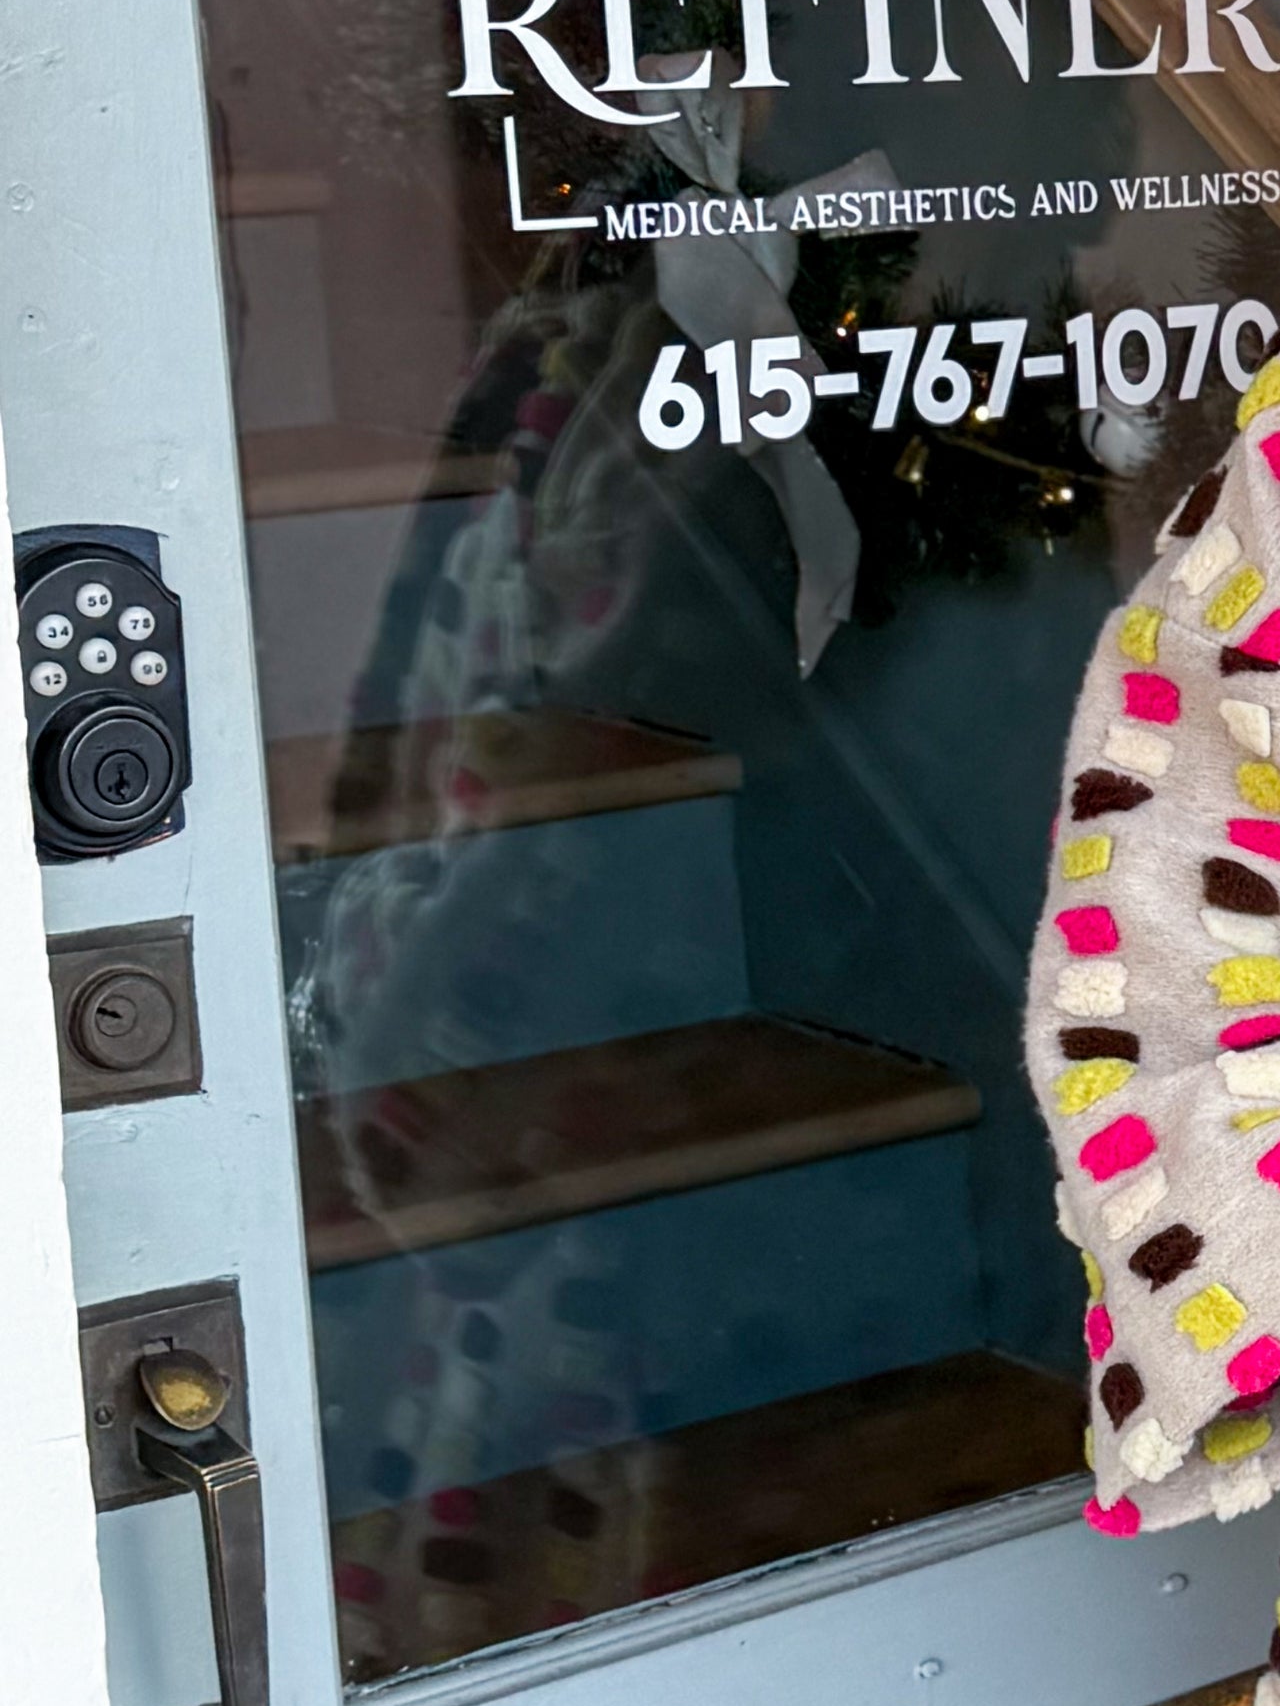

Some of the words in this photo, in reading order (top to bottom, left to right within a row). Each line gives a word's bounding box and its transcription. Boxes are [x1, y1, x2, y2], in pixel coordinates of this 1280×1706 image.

[604, 196, 778, 241] MEDICAL
[789, 184, 1016, 231] AESTHETICS
[1030, 179, 1099, 217] AND
[1110, 169, 1280, 211] WELLNESS
[638, 299, 1280, 450] 615-767-1070
